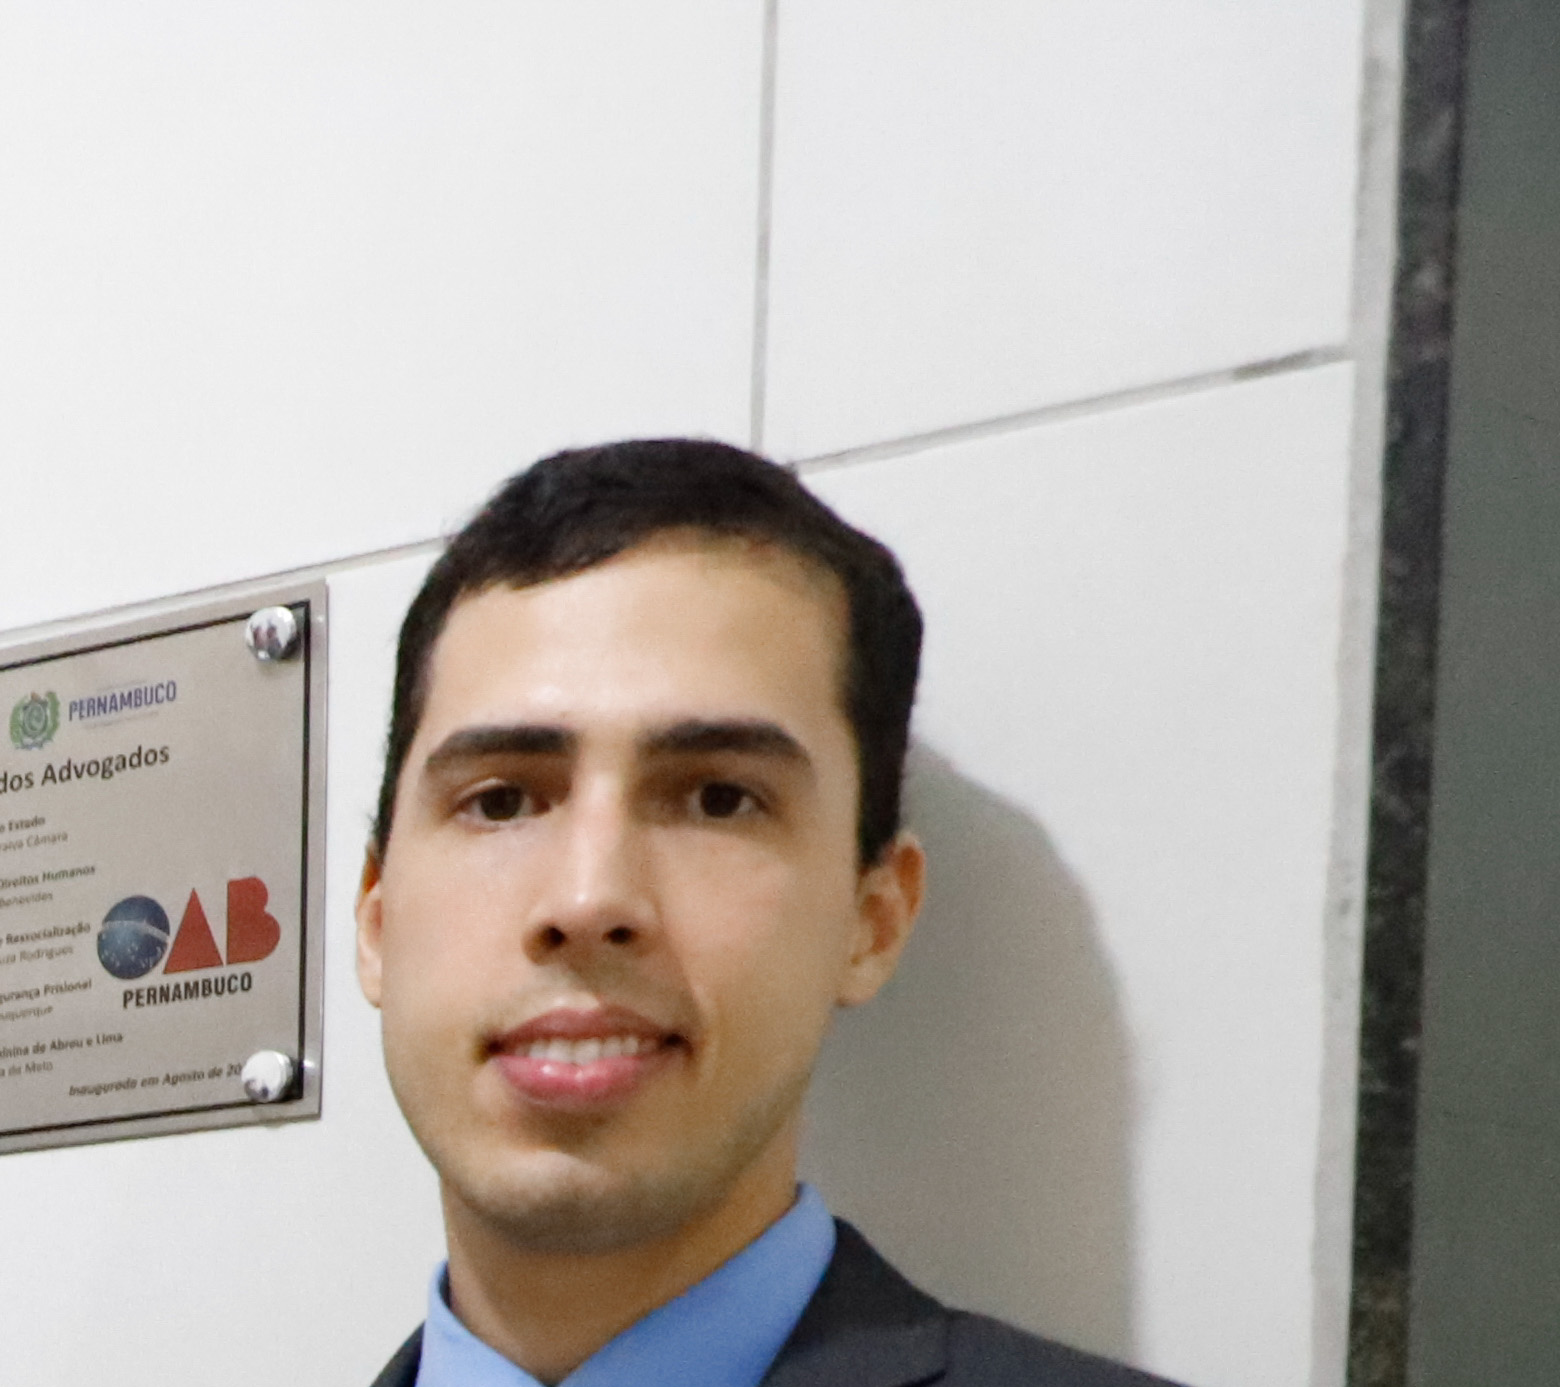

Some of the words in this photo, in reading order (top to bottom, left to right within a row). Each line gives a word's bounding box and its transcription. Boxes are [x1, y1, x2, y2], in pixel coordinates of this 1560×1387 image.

[69, 681, 177, 721] PERNAMBUCO
[40, 744, 170, 785] Advogados
[42, 865, 96, 882] Humanos
[96, 876, 281, 980] OAB
[122, 972, 253, 1009] PERNAMBUCO
[162, 1069, 205, 1088] Agosto
[207, 1066, 224, 1079] de
